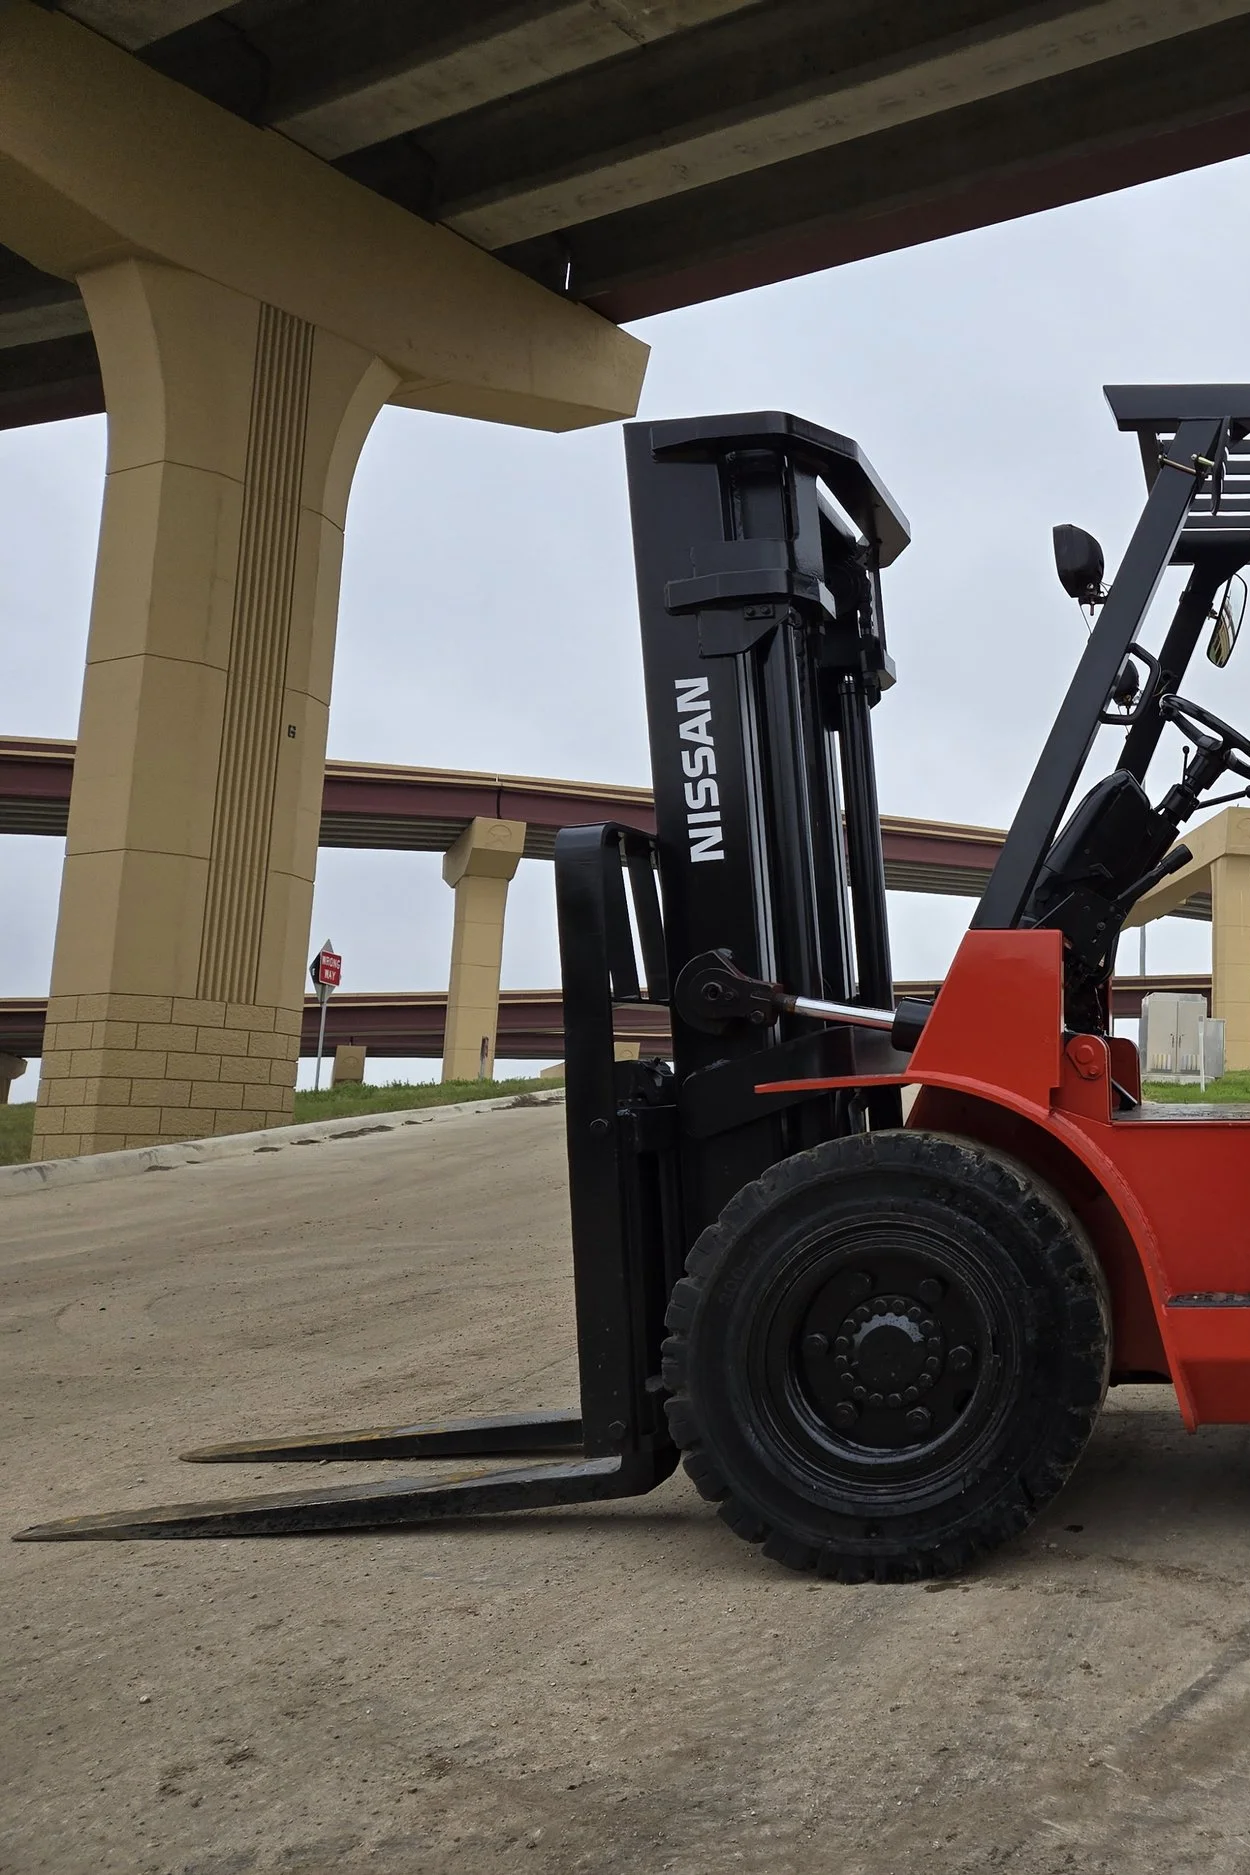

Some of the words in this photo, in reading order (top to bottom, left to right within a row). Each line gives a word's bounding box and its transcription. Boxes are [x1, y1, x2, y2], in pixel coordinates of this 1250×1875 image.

[674, 676, 725, 863] NISSAN
[321, 955, 341, 970] WRONG
[324, 969, 337, 981] WAY
